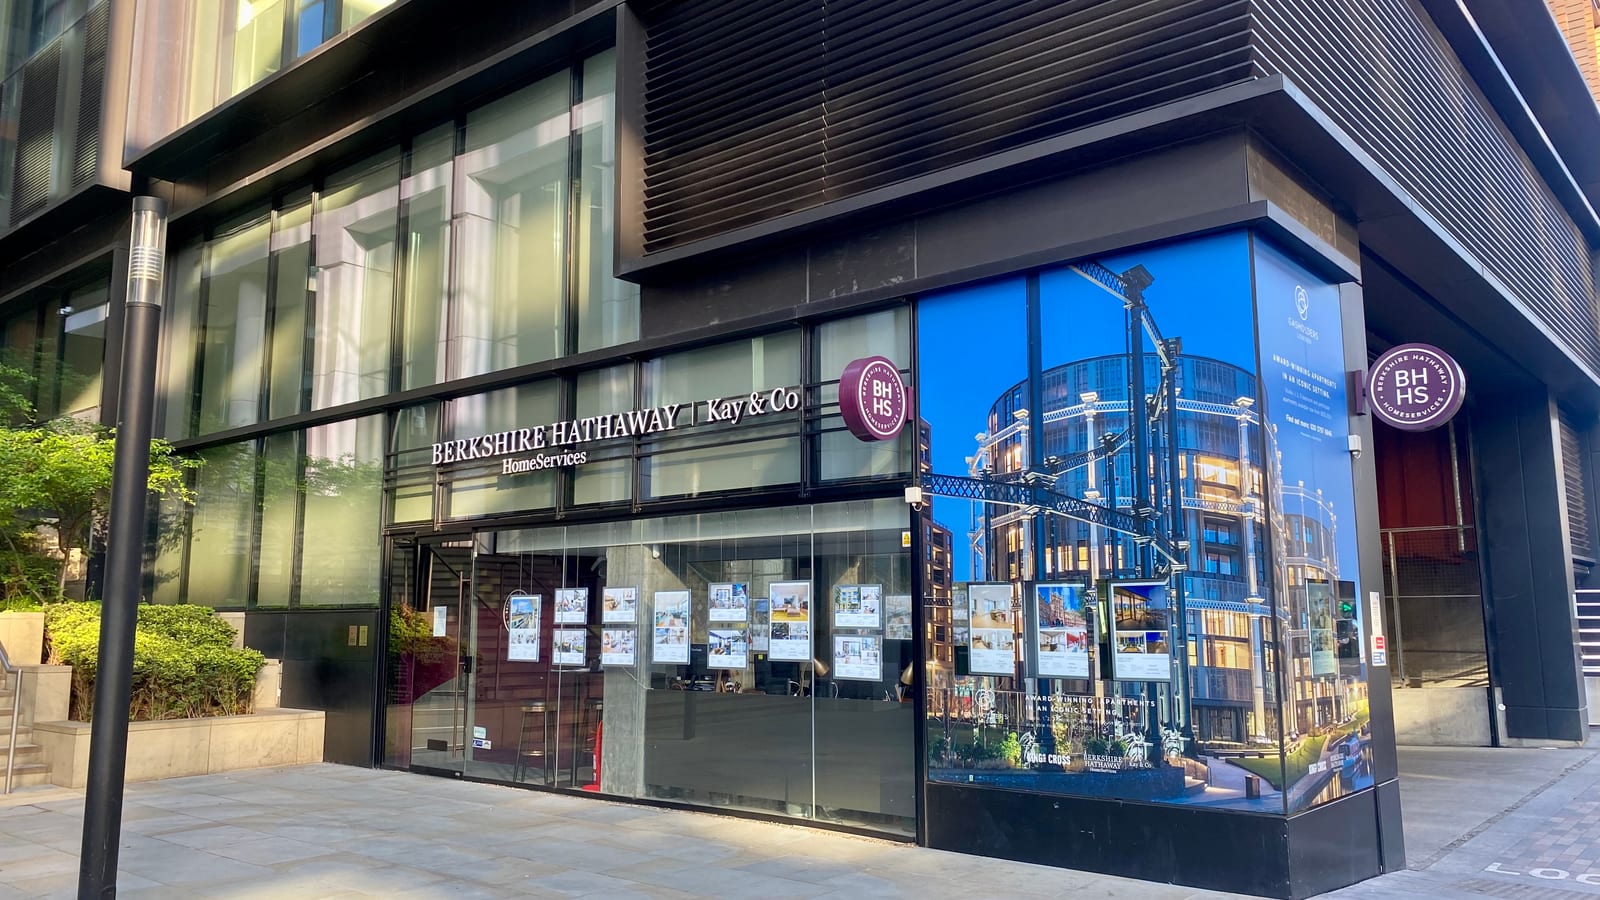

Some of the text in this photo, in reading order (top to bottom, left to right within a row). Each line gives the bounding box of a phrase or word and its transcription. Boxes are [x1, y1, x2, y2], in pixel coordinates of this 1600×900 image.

[1377, 354, 1448, 391] BERKSHIRE HATHAWAY
[1395, 367, 1428, 387] BH
[873, 379, 892, 400] BH
[1396, 386, 1429, 406] HS
[873, 397, 893, 417] HS
[1383, 396, 1444, 418] HOMESERVICES
[431, 387, 799, 465] BERKSHIRE HATHAWAY Kay & Co
[502, 449, 587, 474] HomeServices
[1100, 698, 1156, 707] APARTMENTS
[1047, 754, 1072, 767] CROSS
[1083, 753, 1123, 763] BERKSHIRE
[1084, 760, 1123, 770] HATHAWAY
